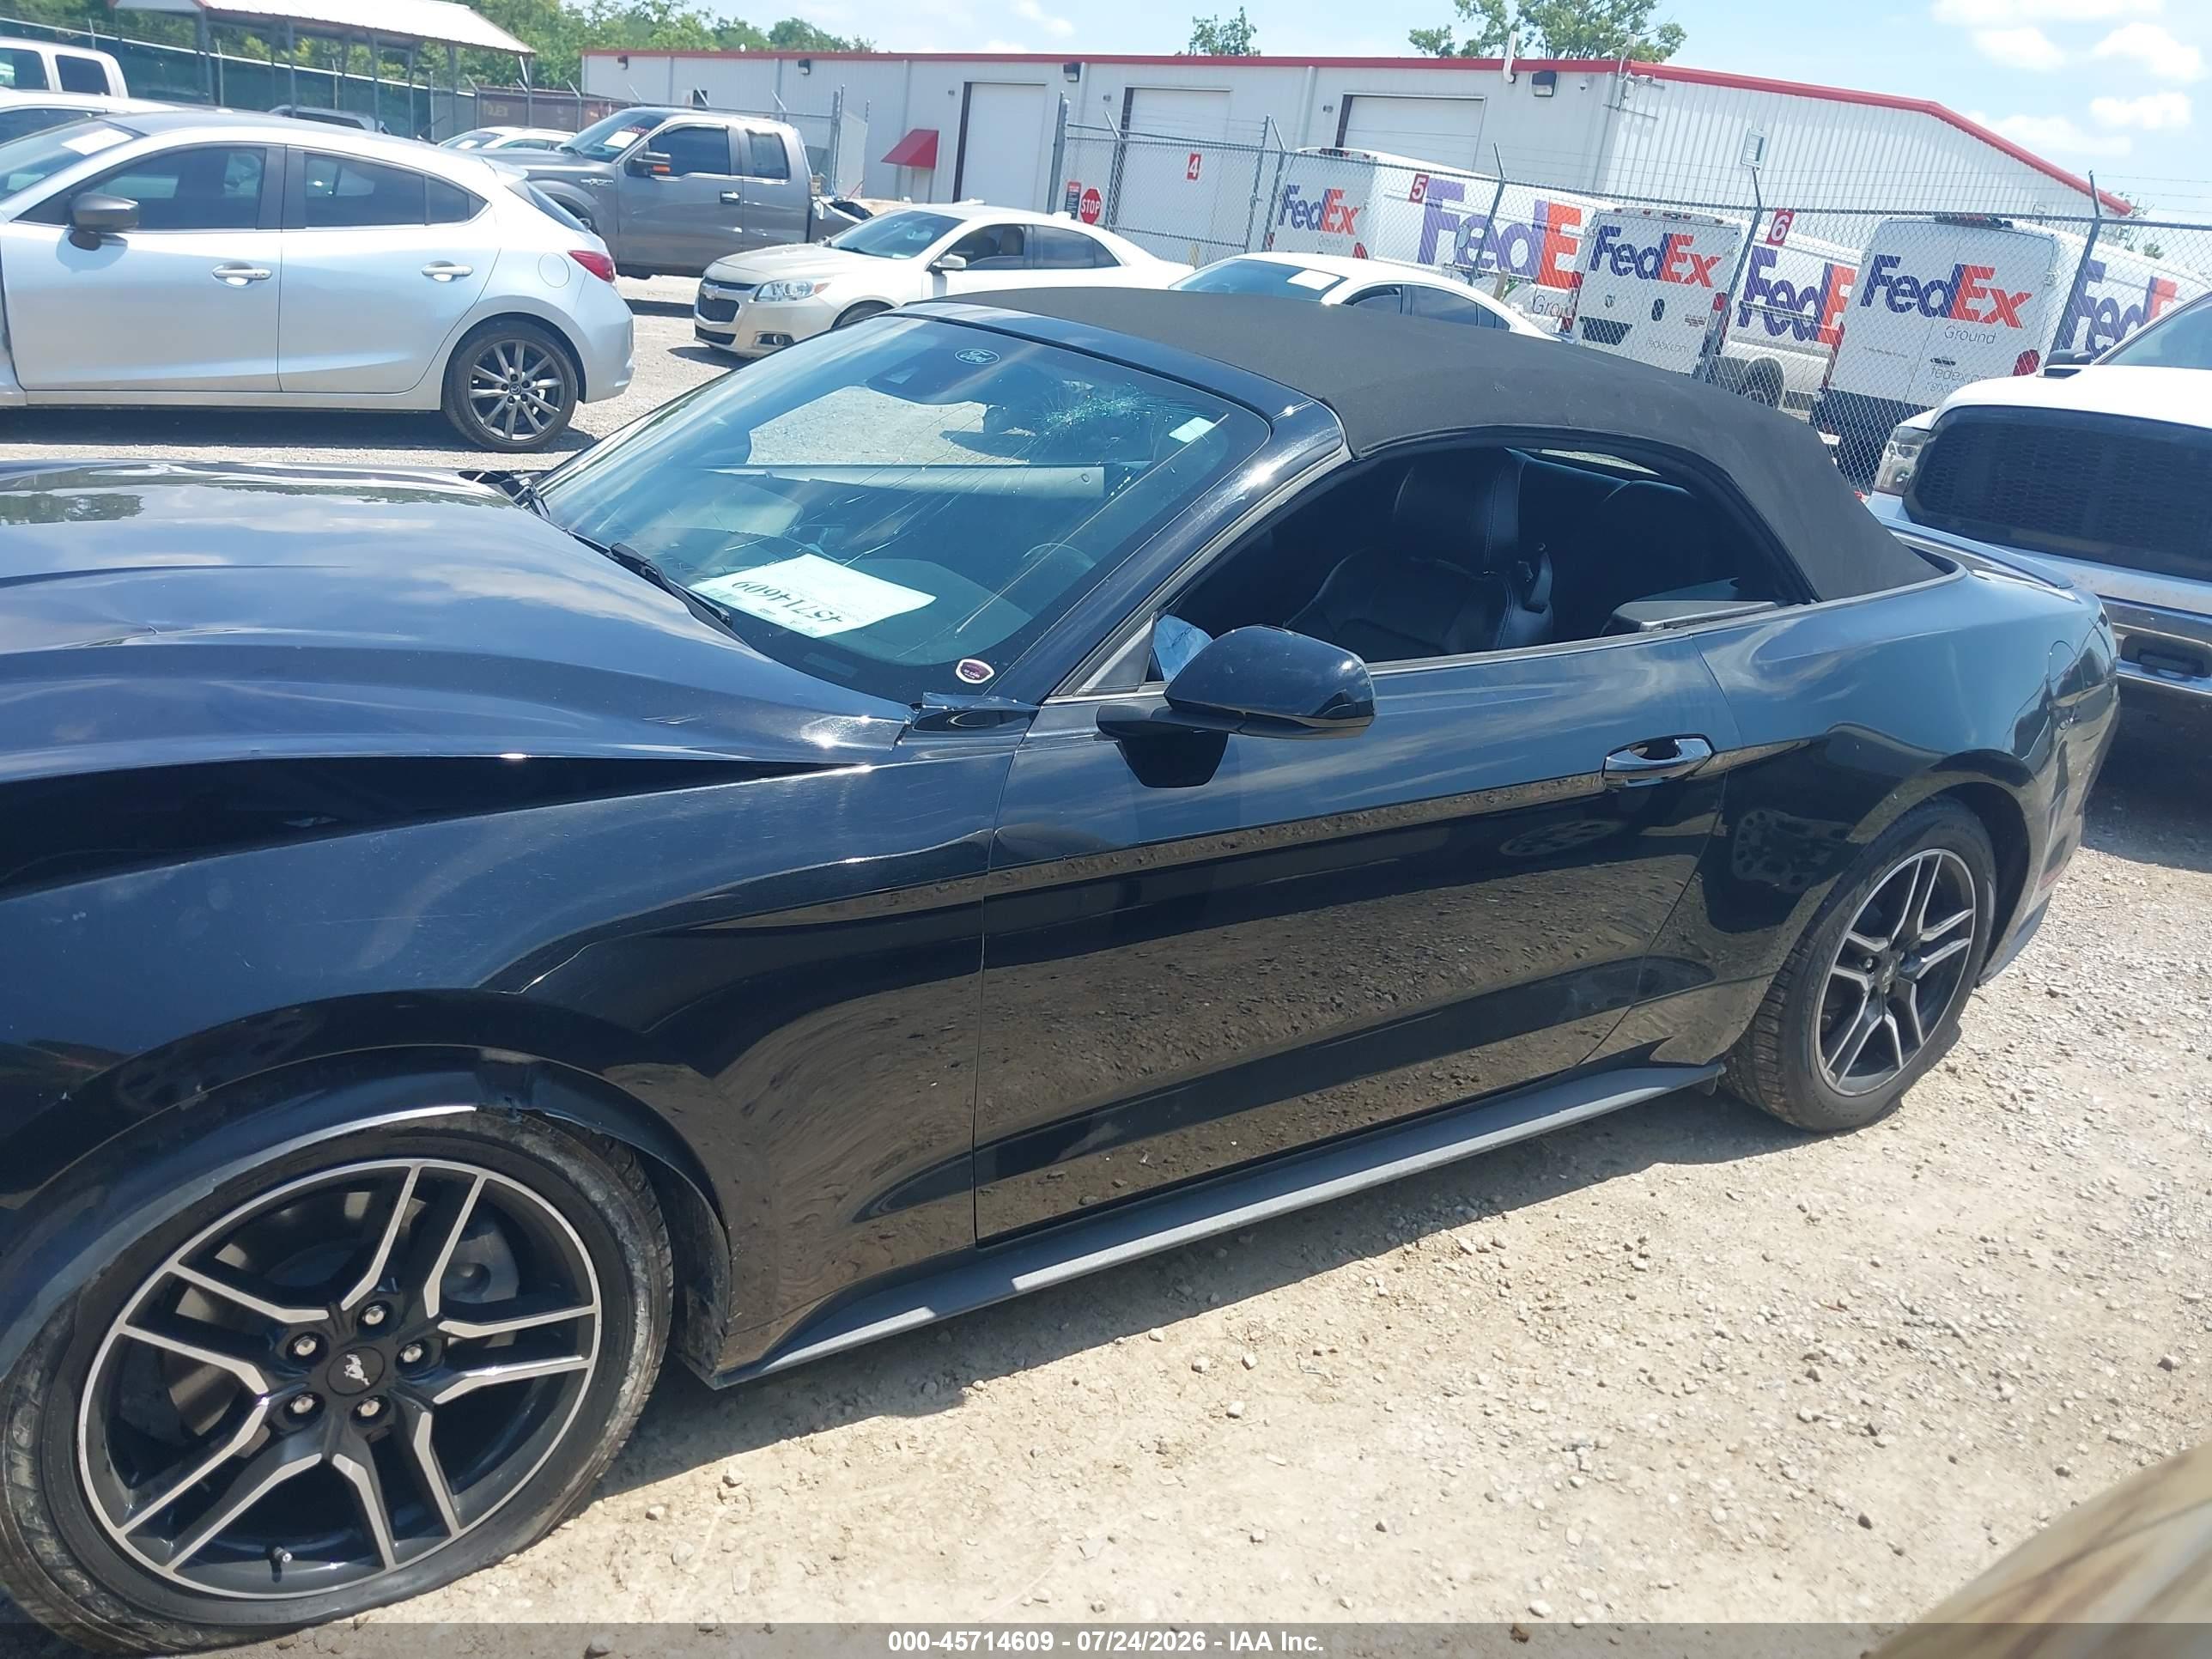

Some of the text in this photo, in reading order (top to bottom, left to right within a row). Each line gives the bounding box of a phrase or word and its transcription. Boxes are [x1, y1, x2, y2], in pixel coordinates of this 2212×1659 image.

[1189, 156, 1199, 178] 4
[1413, 177, 1427, 199] 5
[1080, 198, 1101, 215] STOP
[1278, 185, 1361, 235] FedEx
[1771, 215, 1790, 241] 6
[1589, 225, 1723, 289] FedEx
[1859, 253, 2033, 329] FedEx
[1943, 325, 1997, 344] Ground
